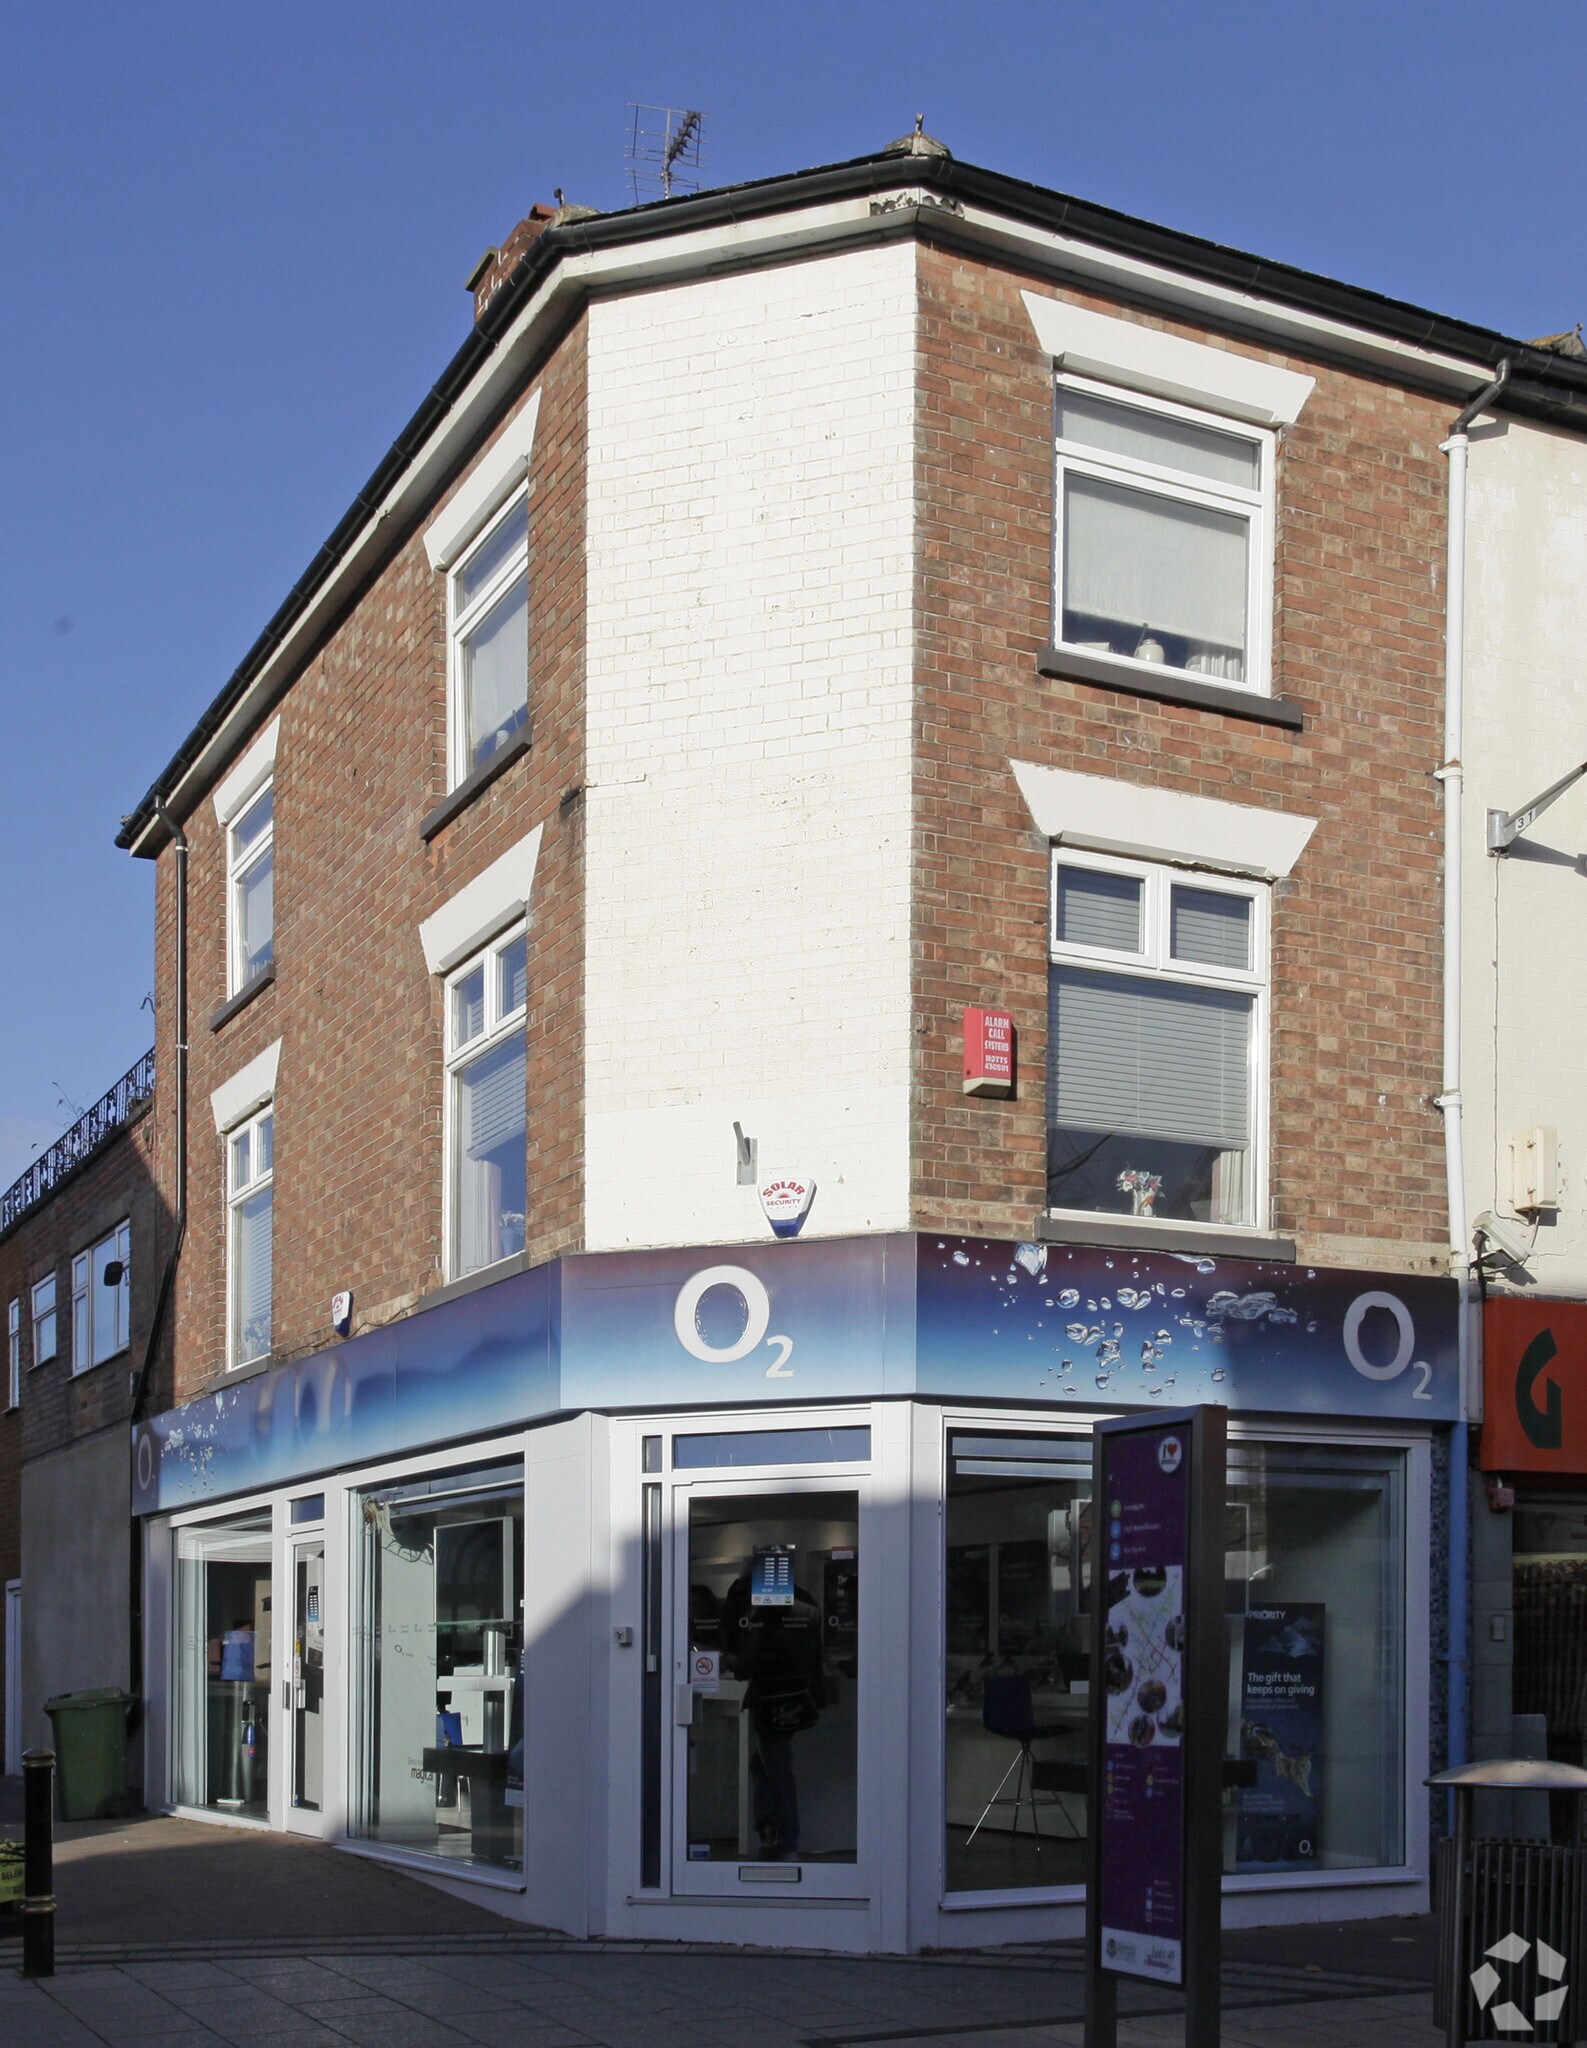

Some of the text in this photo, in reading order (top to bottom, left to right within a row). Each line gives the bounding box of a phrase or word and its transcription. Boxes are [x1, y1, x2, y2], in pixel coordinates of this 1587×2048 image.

[984, 1016, 1009, 1028] ALARM
[988, 1028, 1005, 1040] CALL
[984, 1040, 1009, 1051] SYSTEMS
[762, 1181, 806, 1197] SOLAR
[1248, 1609, 1286, 1620] PRIORITY
[1248, 1672, 1301, 1685] The gift that
[1247, 1684, 1315, 1696] keeps on giving
